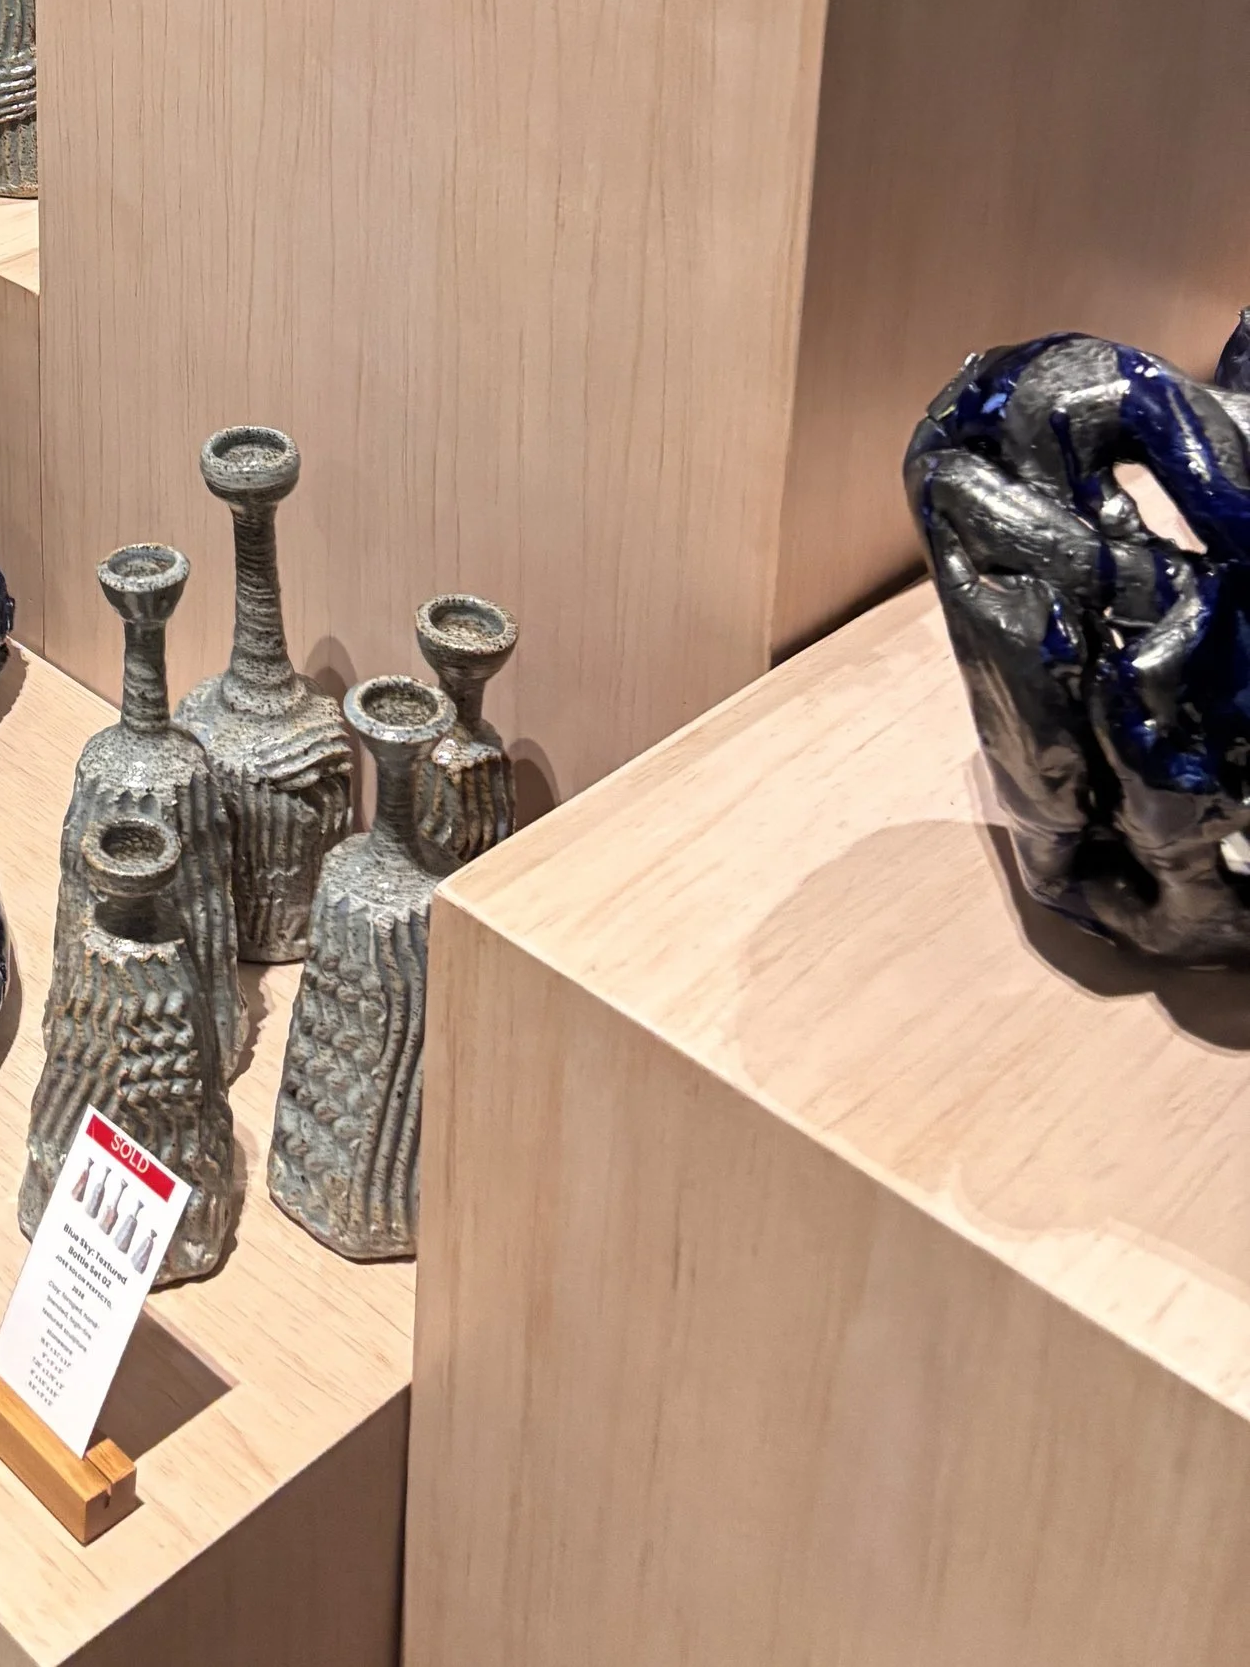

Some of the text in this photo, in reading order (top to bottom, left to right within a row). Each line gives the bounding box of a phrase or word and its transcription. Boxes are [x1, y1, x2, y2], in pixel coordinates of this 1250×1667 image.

[110, 1133, 149, 1173] SOLD
[63, 1223, 128, 1285] Blue Sky: Textured
[68, 1246, 112, 1290] Bottle Set 02
